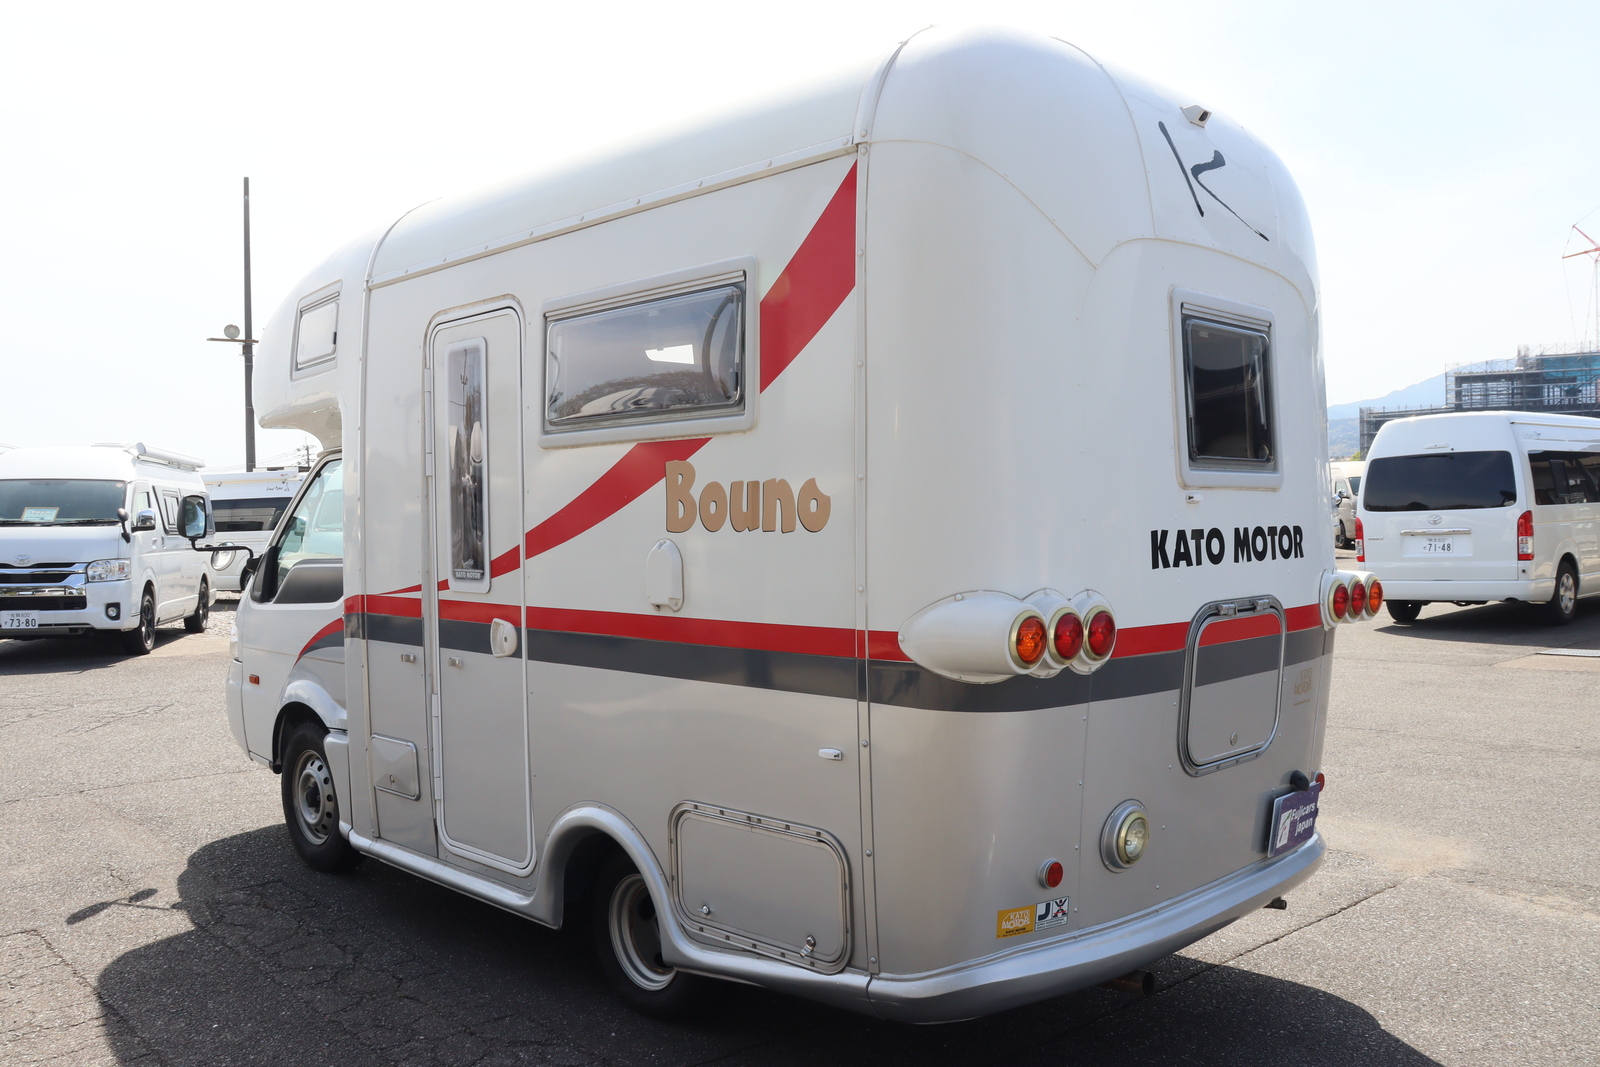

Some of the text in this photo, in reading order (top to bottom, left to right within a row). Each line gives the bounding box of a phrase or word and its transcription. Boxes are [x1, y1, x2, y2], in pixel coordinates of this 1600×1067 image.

[665, 459, 831, 534] Bouno
[1151, 525, 1305, 570] KATO MOTOR
[1428, 543, 1451, 552] 71-48
[10, 618, 36, 627] 73-80
[1291, 803, 1315, 821] Fujicars
[1295, 818, 1313, 836] japan
[1010, 911, 1030, 921] KATO
